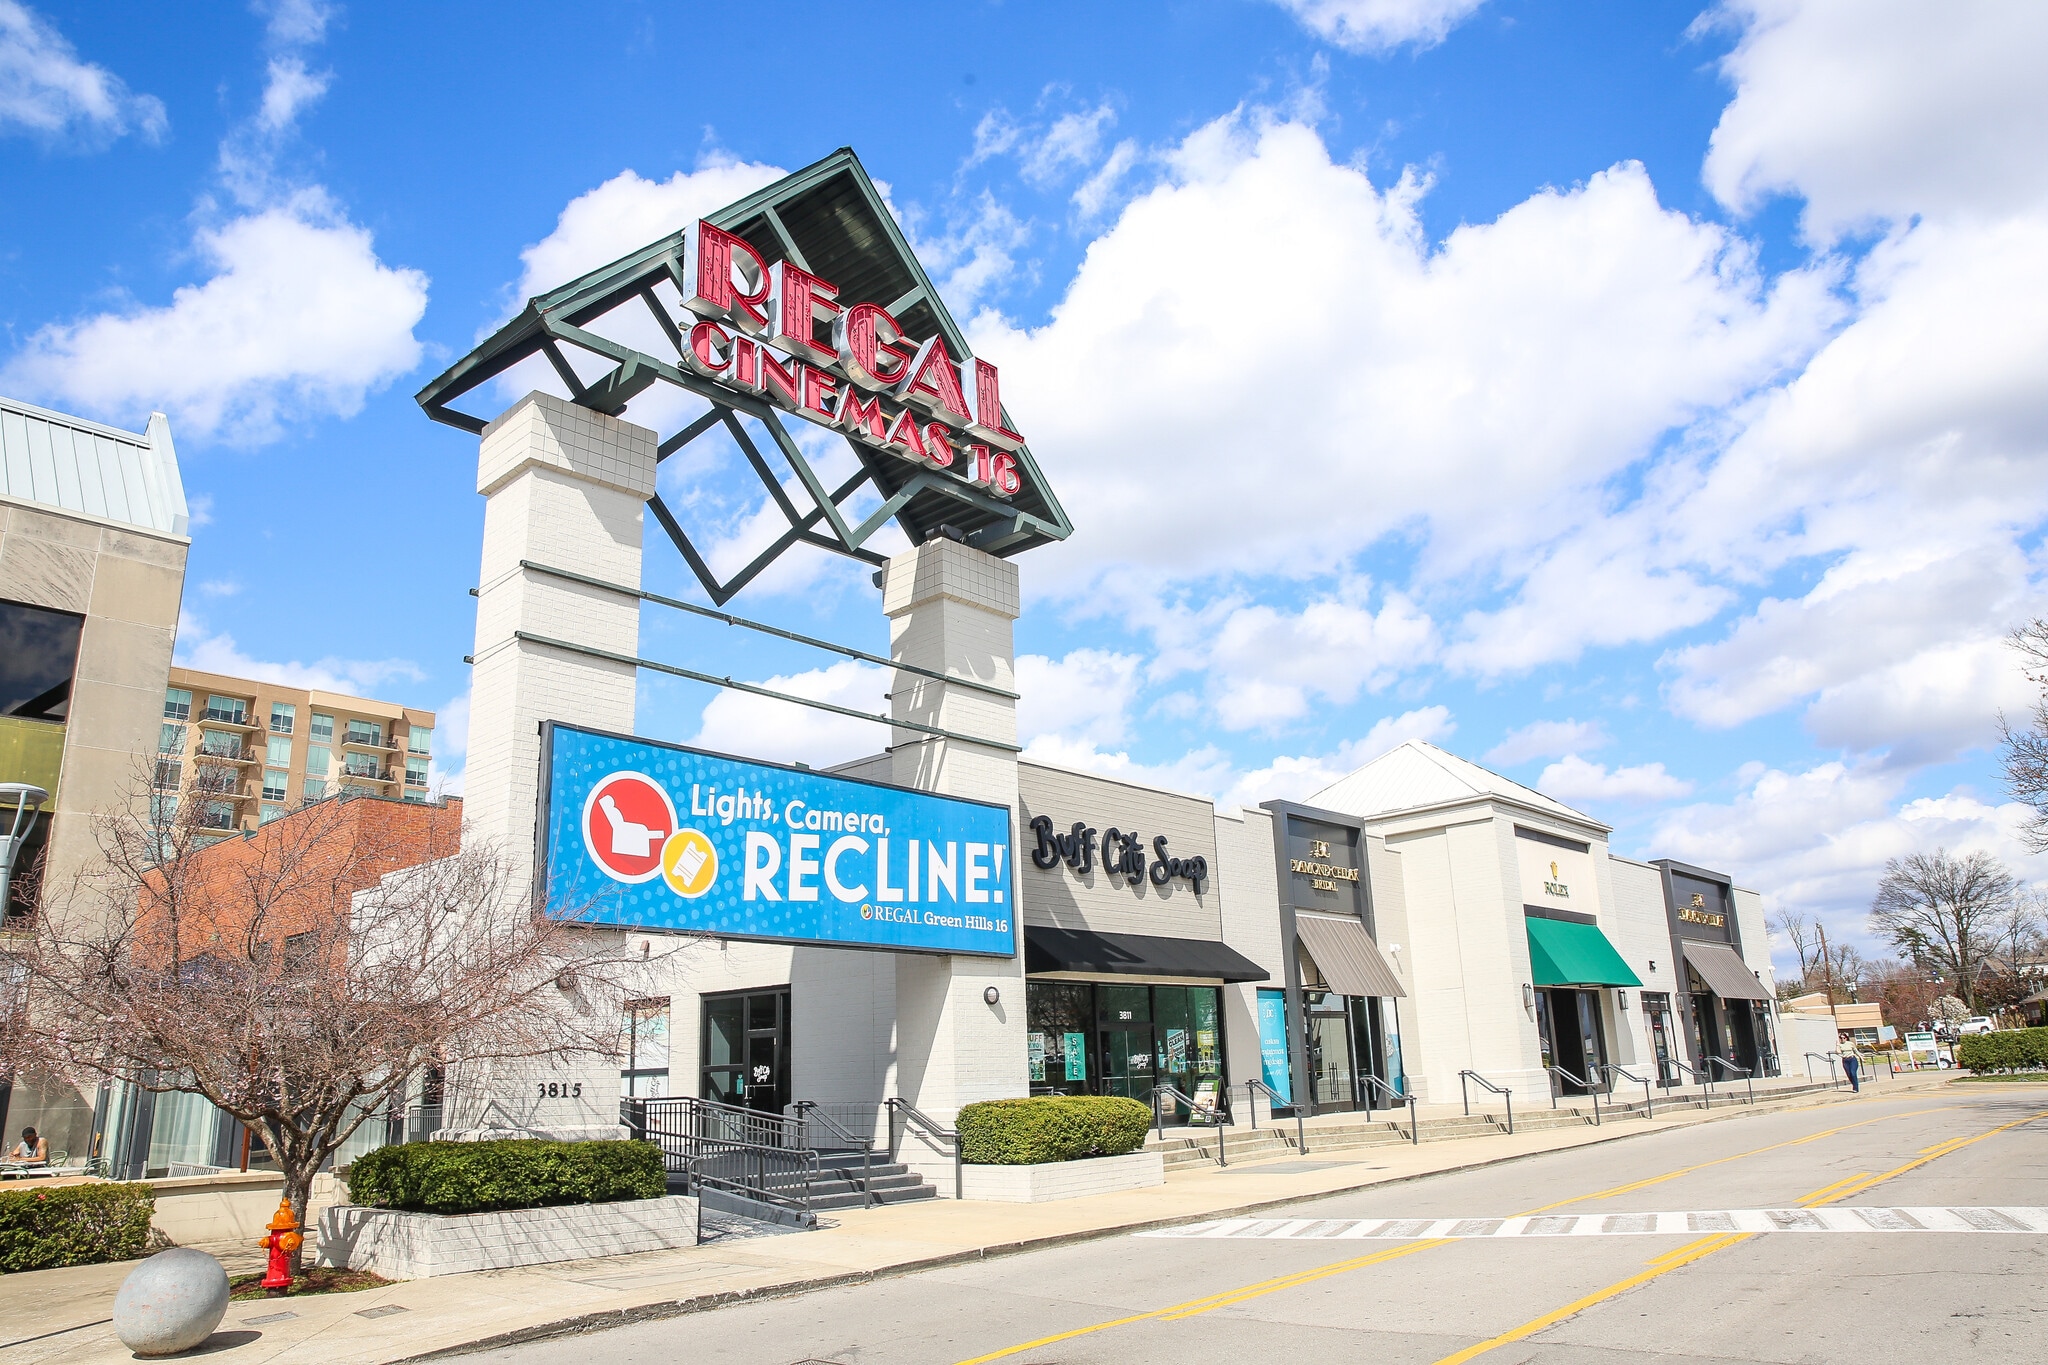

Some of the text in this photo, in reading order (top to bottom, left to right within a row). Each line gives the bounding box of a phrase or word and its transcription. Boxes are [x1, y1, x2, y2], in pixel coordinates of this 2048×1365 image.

[680, 218, 1025, 451] REGAL
[681, 320, 1021, 497] CINEMAS 16
[691, 783, 891, 838] Lights, Camera,
[743, 831, 1005, 904] RECLINE!
[1030, 815, 1208, 895] Buff City Soap
[1543, 881, 1570, 899] ROLEX
[874, 905, 1008, 933] REGAL Green Hills 16
[1119, 1010, 1132, 1020] 3811
[1071, 1036, 1079, 1077] SALE
[1169, 1036, 1184, 1048] CLEAN
[537, 1082, 582, 1099] 3815
